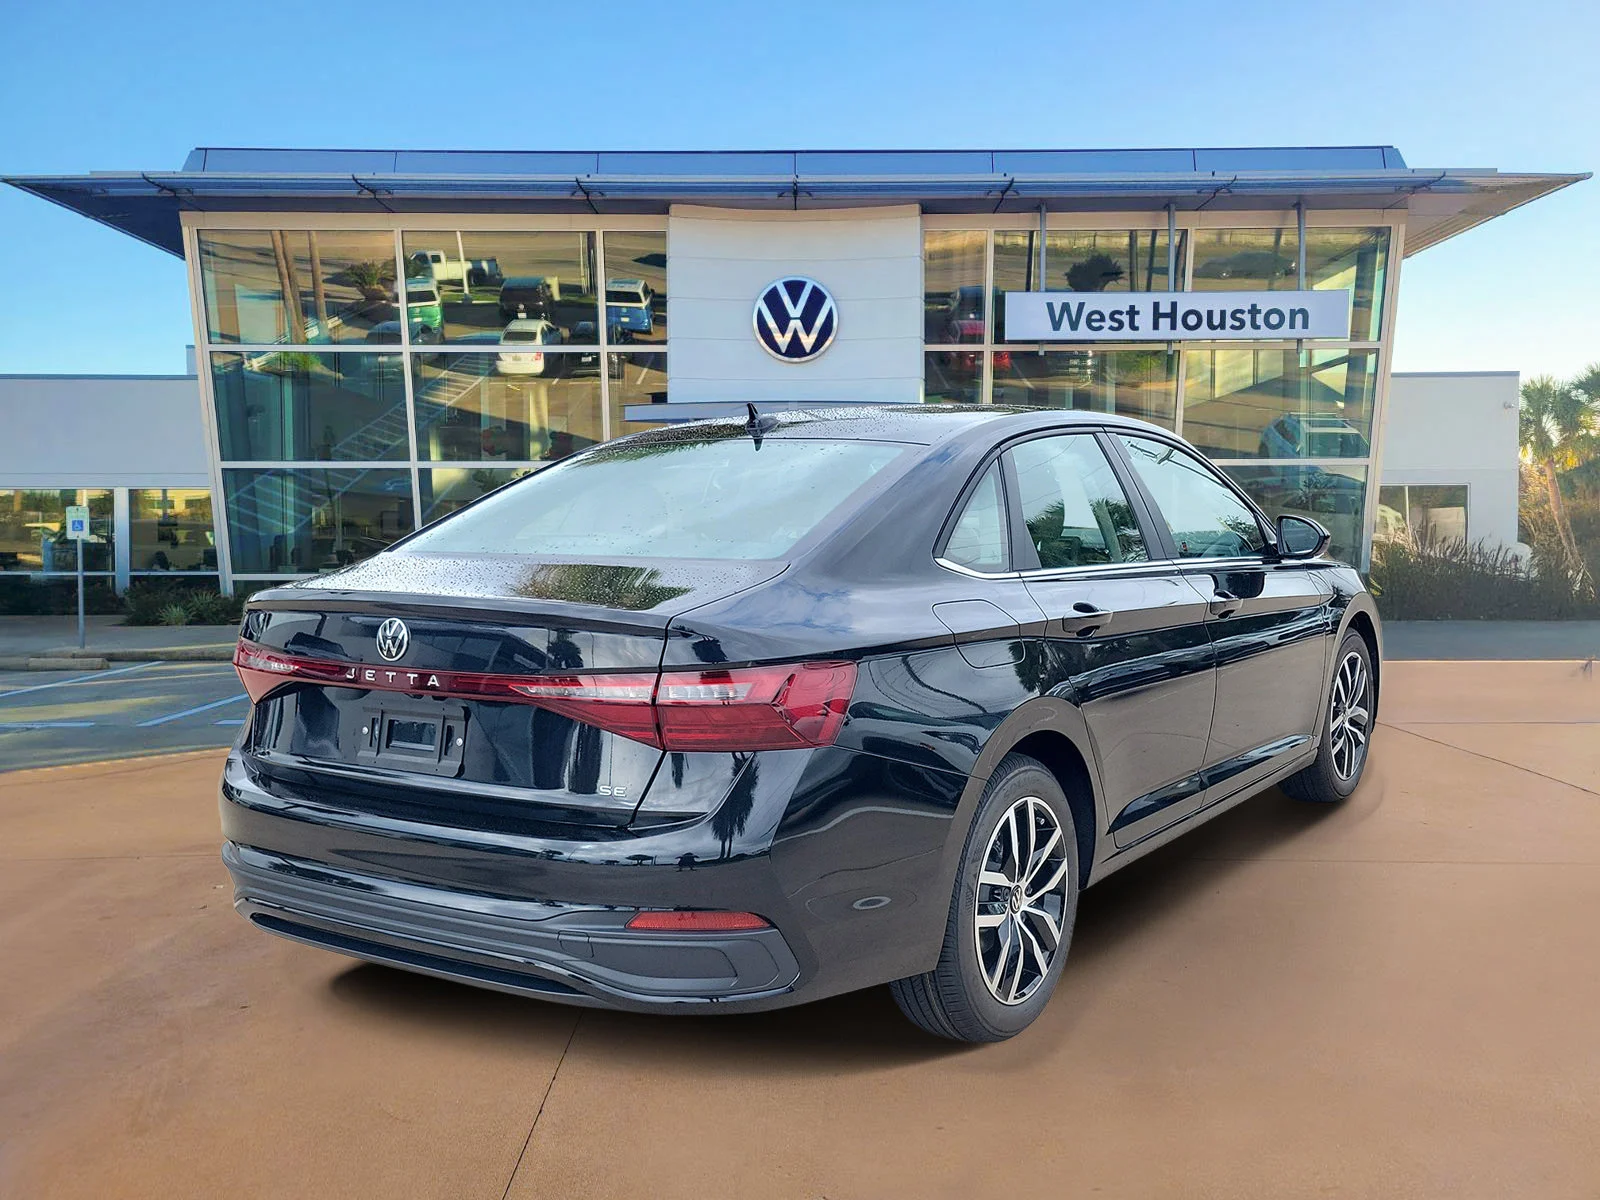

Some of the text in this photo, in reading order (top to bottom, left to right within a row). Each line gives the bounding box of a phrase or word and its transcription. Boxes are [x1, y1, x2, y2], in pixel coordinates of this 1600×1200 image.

[1046, 301, 1309, 331] West Houston
[346, 667, 439, 687] JETTA
[599, 785, 627, 797] SE
